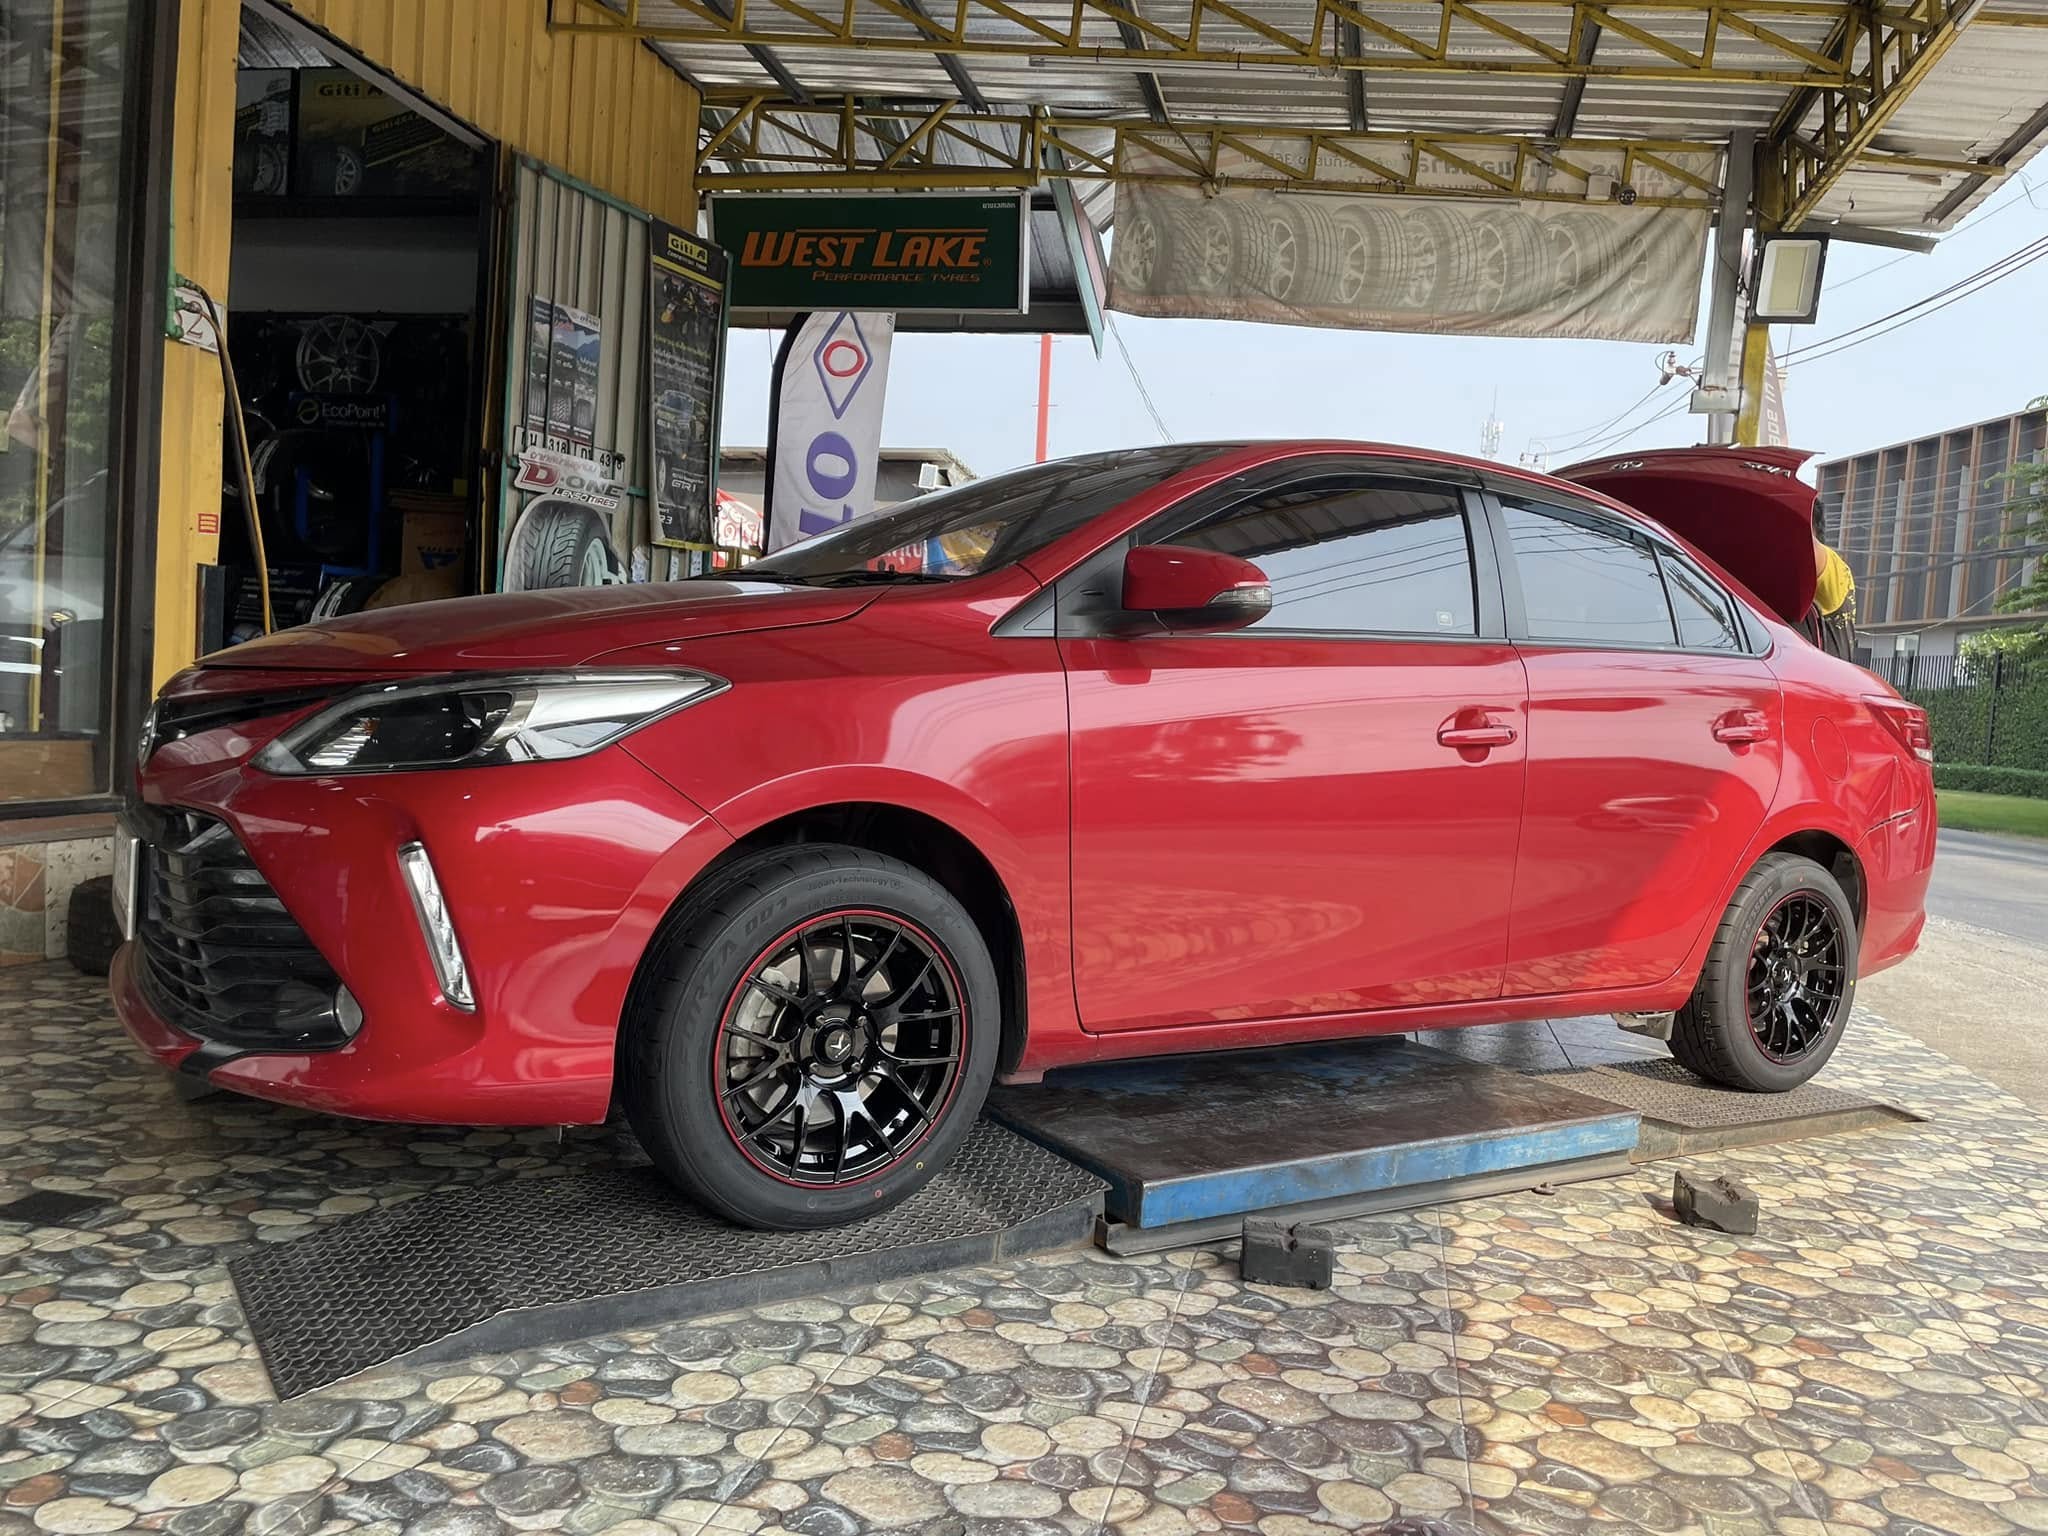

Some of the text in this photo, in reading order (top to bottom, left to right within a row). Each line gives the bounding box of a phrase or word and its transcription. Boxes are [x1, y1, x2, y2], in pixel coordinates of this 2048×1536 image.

[671, 238, 693, 261] Giti
[741, 231, 865, 267] WEST
[872, 231, 986, 267] LAKE
[812, 270, 980, 282] PERFORMANCE TYRES
